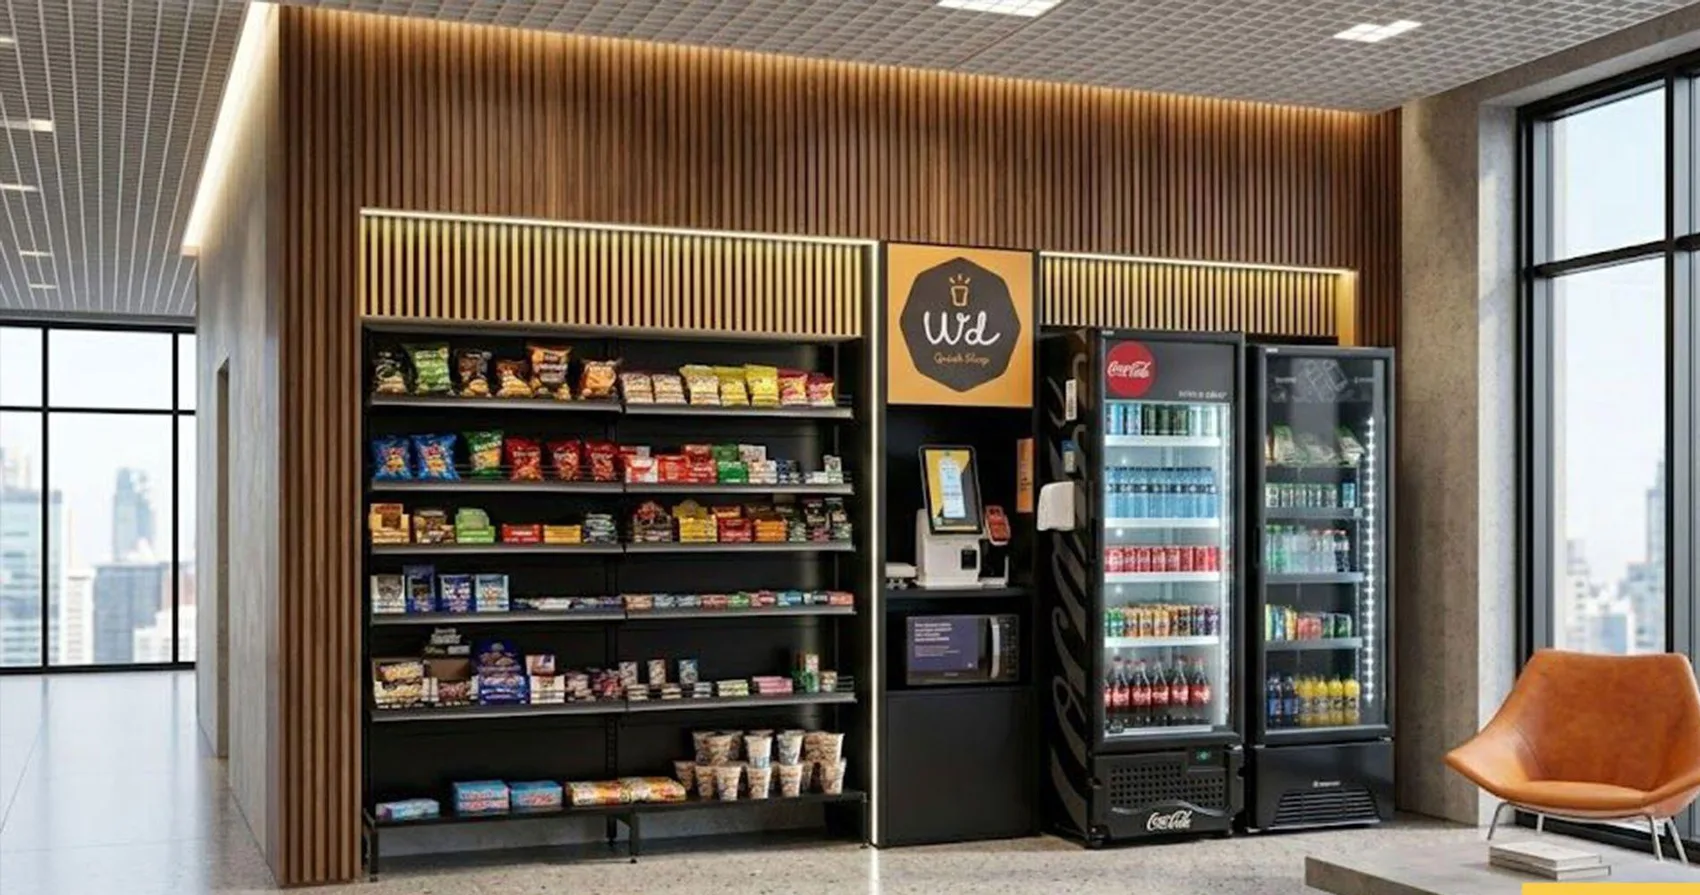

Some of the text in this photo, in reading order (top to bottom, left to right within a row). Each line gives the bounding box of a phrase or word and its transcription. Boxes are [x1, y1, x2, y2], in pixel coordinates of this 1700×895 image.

[923, 310, 1001, 346] Wd
[1107, 360, 1152, 379] Coca-Cola
[1146, 810, 1193, 832] Coca-Cola
